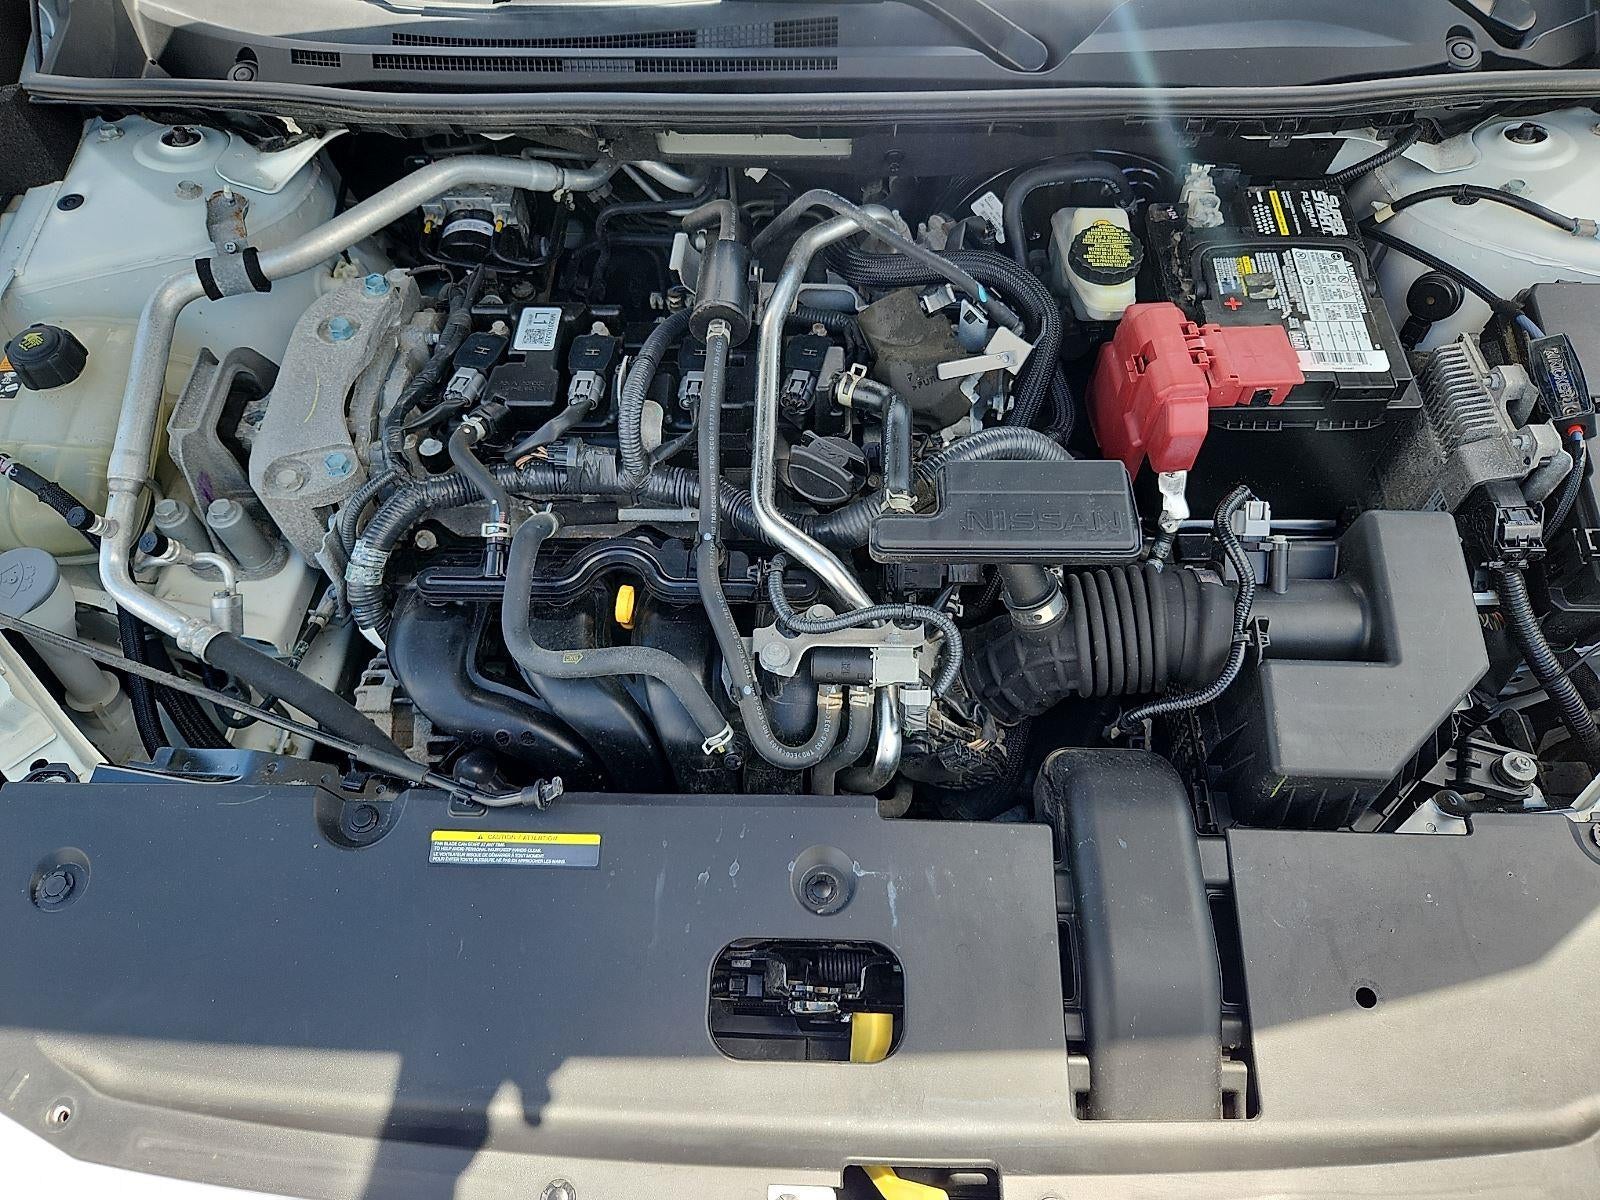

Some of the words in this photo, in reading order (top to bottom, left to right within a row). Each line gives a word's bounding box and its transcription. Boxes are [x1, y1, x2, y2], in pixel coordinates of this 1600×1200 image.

[1301, 191, 1318, 228] PLATINUM
[1311, 190, 1333, 235] START
[1327, 195, 1348, 236] SUPER
[965, 509, 1124, 533] NISSAN
